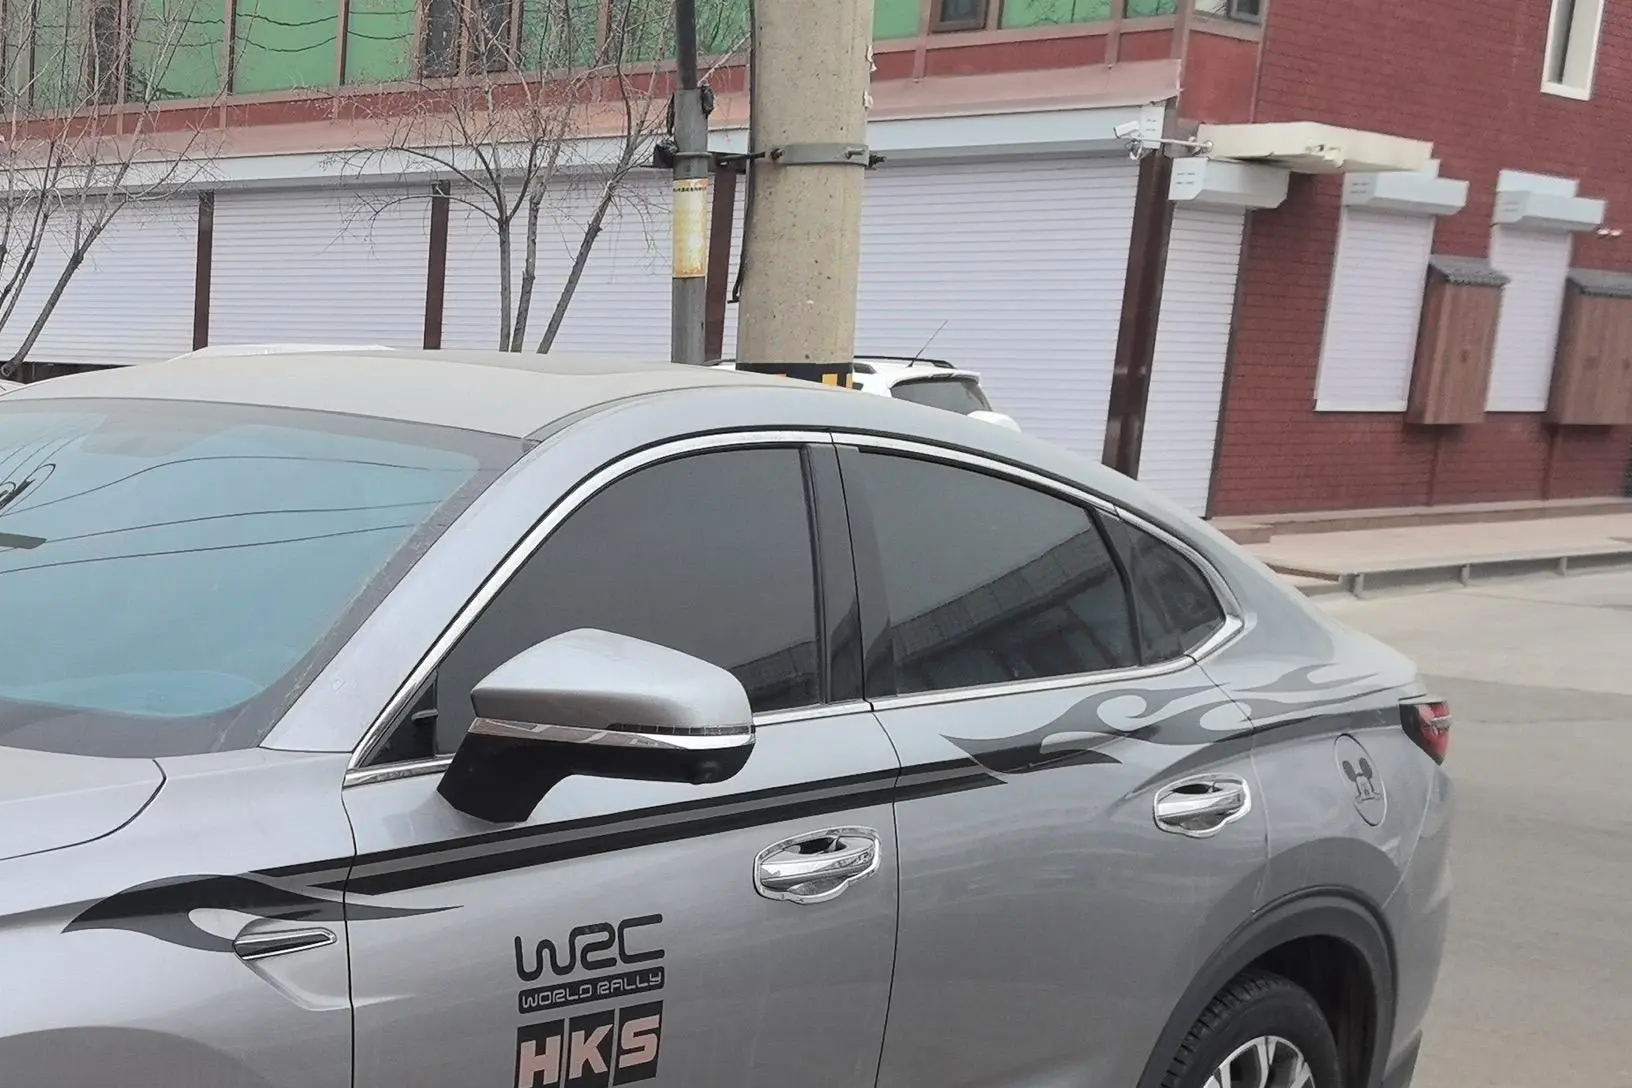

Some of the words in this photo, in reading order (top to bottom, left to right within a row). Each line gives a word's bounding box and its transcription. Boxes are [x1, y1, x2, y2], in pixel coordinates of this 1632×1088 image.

[514, 913, 666, 982] WRC
[522, 984, 593, 1009] WORLD
[597, 971, 662, 995] RALLY
